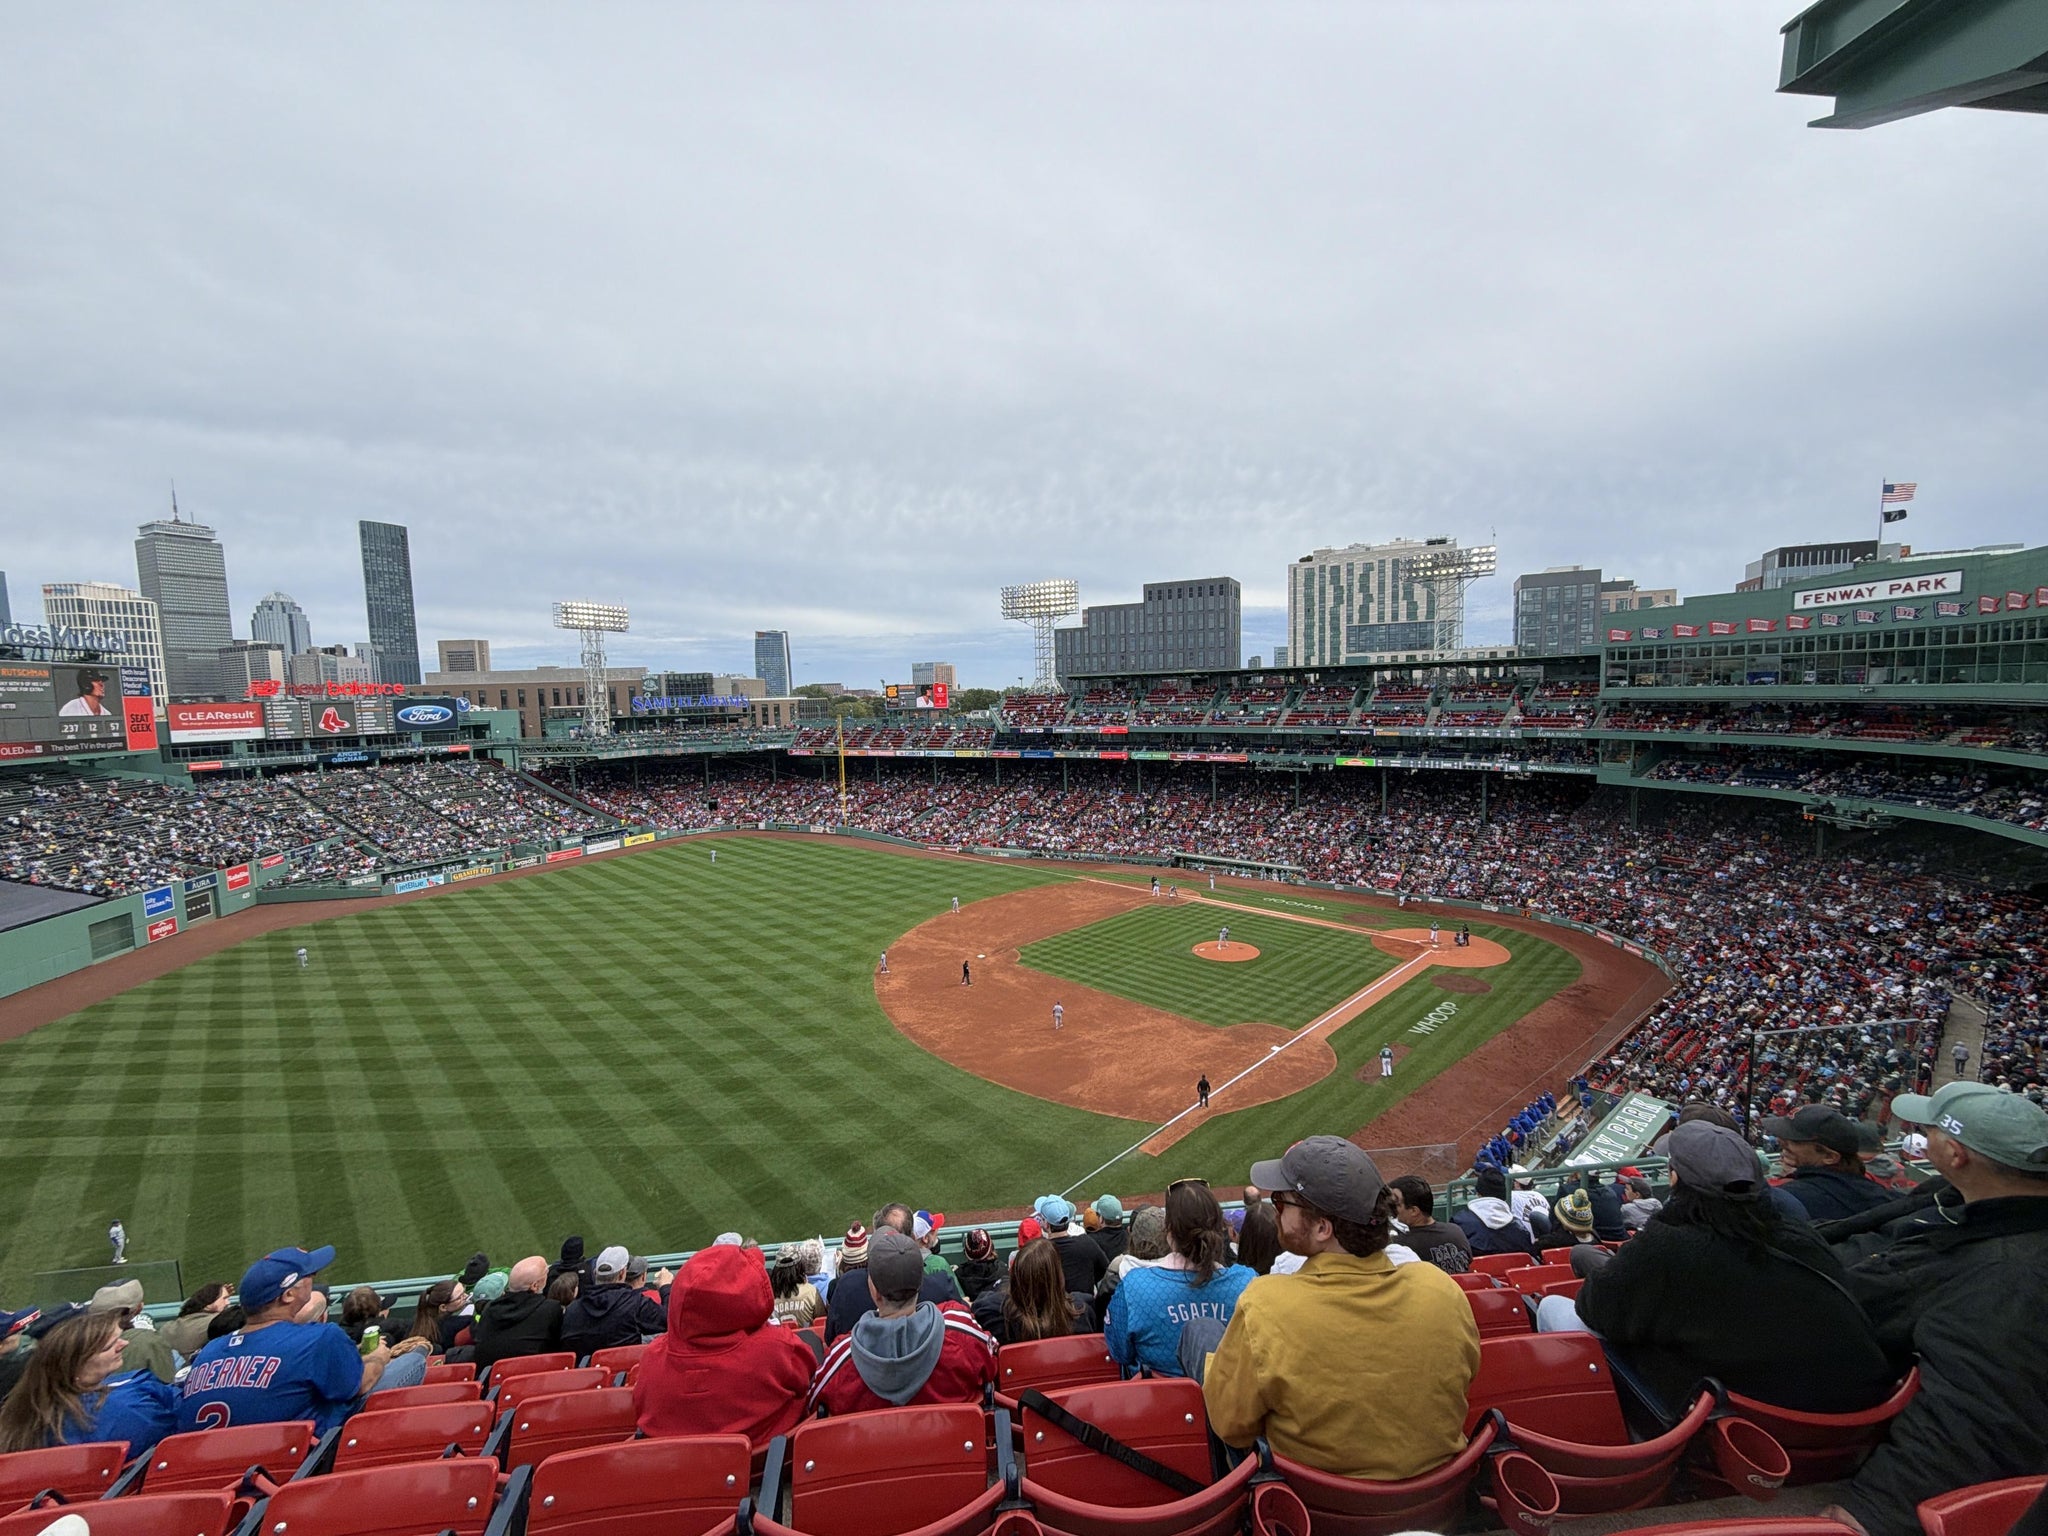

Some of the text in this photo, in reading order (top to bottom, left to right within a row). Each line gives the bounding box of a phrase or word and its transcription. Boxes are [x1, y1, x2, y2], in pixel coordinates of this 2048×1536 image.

[1802, 577, 1949, 605] FENWAY PARK
[0, 622, 126, 652] assMutual
[285, 684, 325, 696] new
[326, 680, 405, 696] balance
[632, 694, 750, 712] SAMUEL ADAMS
[130, 713, 150, 723] SEAT
[178, 710, 255, 722] CLEAResult
[409, 709, 443, 722] Ford
[61, 724, 79, 733] .237
[89, 723, 97, 732] 12
[110, 723, 119, 731] 57
[130, 723, 152, 733] GEEK
[51, 744, 65, 752] The
[65, 743, 80, 752] best
[80, 742, 89, 750] TV
[106, 741, 123, 749] game
[514, 857, 537, 867] wasabi
[452, 870, 480, 881] GRANITE
[398, 879, 425, 892] jetBlue
[1263, 896, 1326, 911] WHOOP
[152, 924, 174, 935] IRVING
[1408, 1001, 1460, 1035] WHOOP
[1607, 1097, 1663, 1140] PARK
[1940, 1113, 1964, 1135] 35
[183, 1355, 281, 1399] HOERNER
[195, 1401, 232, 1432] 2
